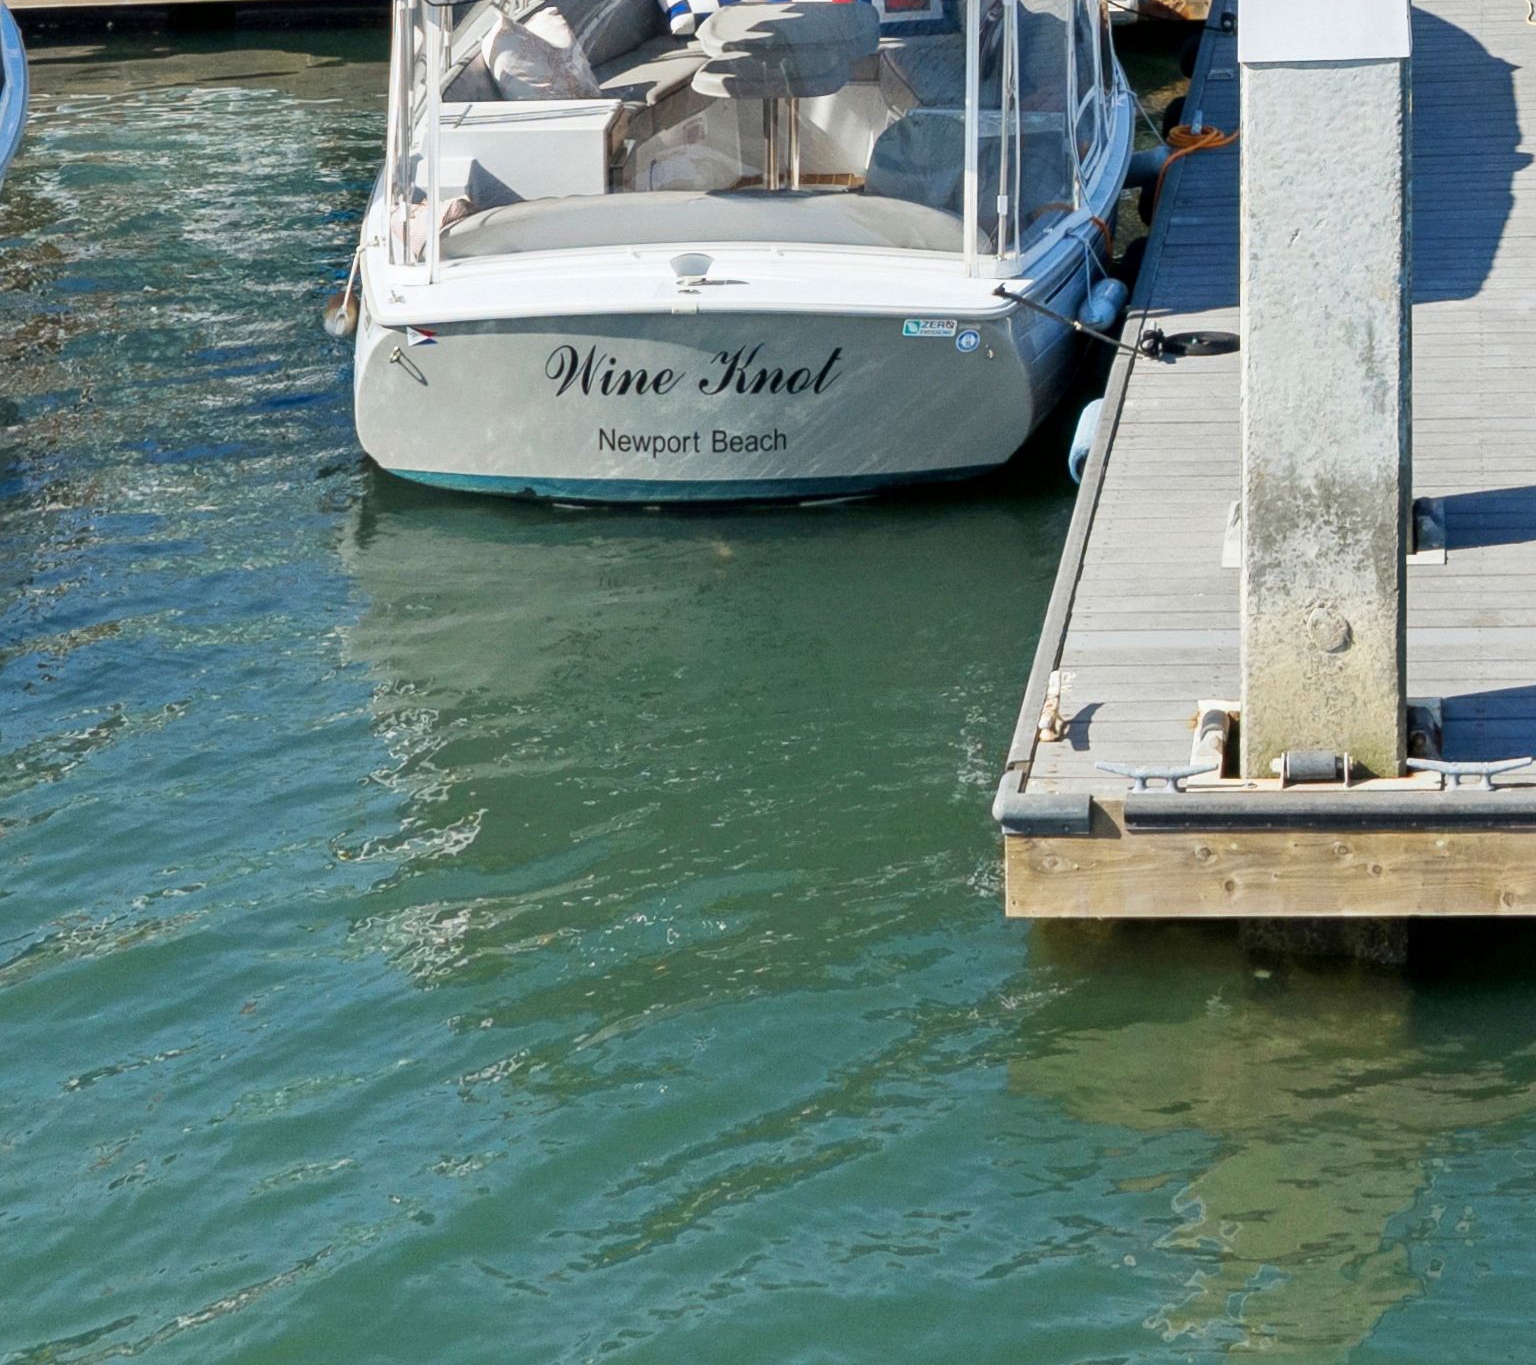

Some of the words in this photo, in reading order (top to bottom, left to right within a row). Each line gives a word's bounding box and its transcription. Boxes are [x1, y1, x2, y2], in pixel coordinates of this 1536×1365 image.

[545, 344, 686, 398] Wine
[698, 342, 843, 396] Knot
[598, 427, 701, 459] Newport
[711, 428, 788, 454] Beach
